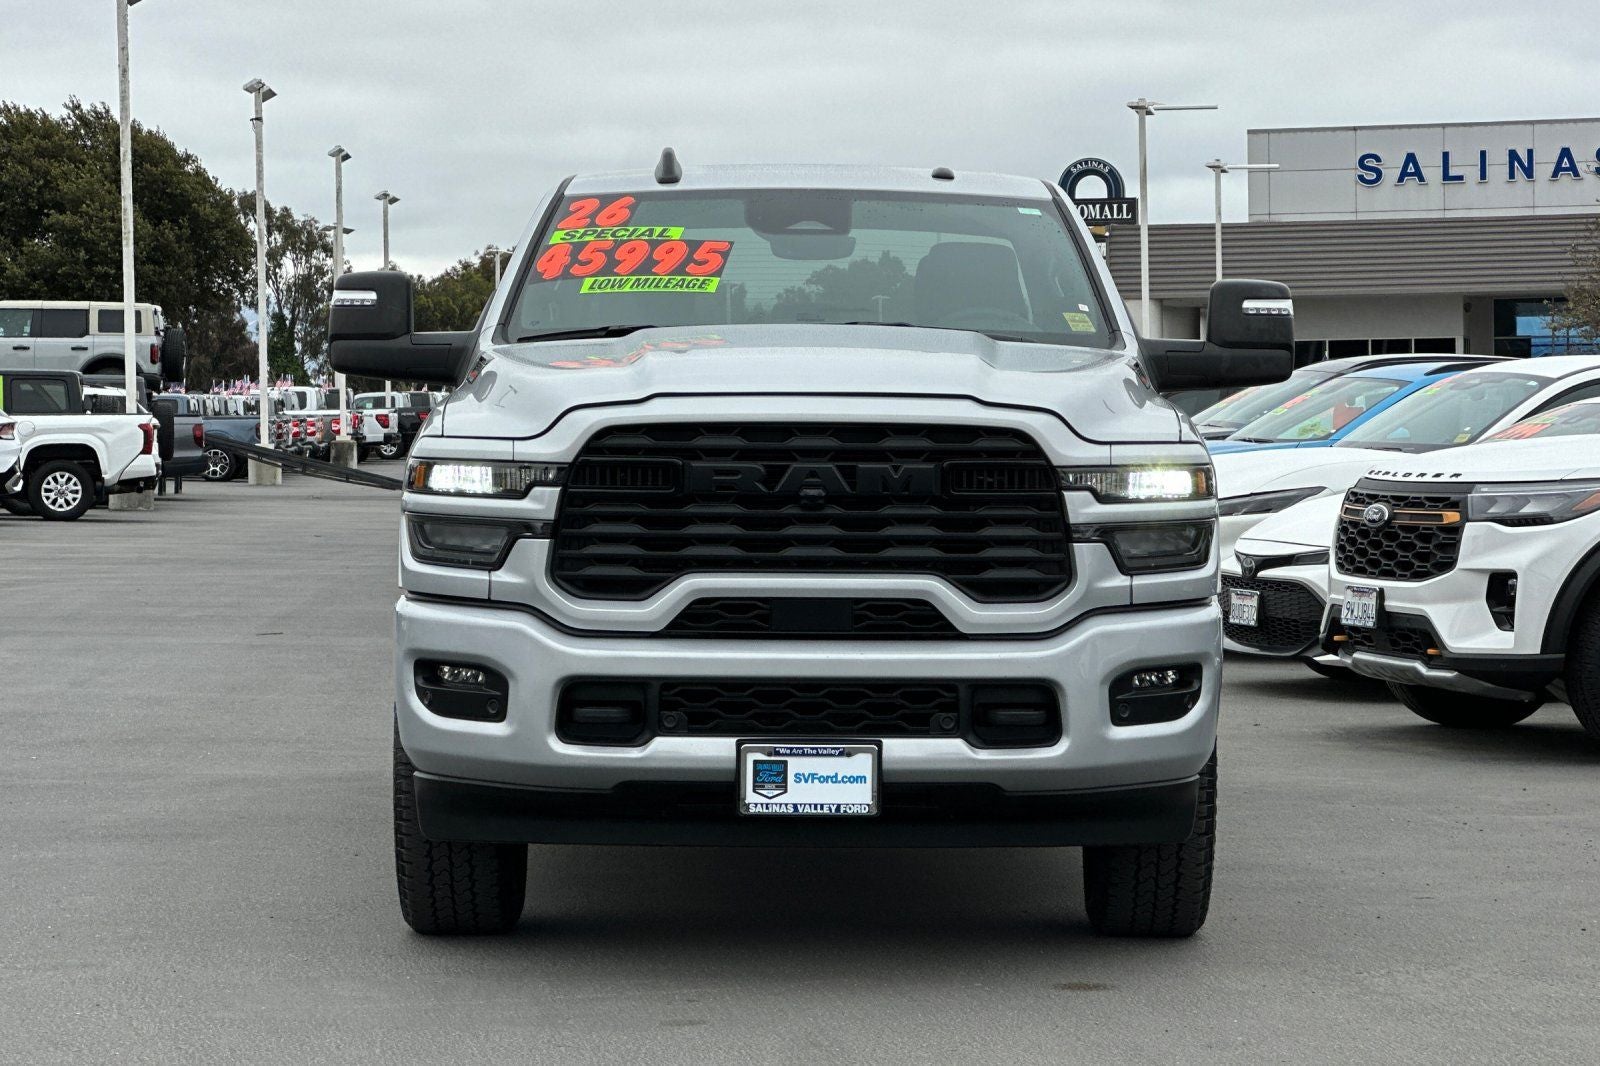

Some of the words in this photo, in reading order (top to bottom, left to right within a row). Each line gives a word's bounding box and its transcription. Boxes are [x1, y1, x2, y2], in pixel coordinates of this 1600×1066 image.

[1070, 160, 1110, 174] SALINAS
[1356, 146, 1600, 187] SALINA
[557, 196, 636, 229] 26
[1074, 203, 1132, 220] OMALL
[559, 226, 672, 241] SPECIAL
[536, 240, 731, 279] 45995
[587, 277, 629, 290] LOW
[629, 277, 713, 290] MILEAGE
[693, 463, 936, 496] RAM
[1367, 469, 1463, 479] EXPLORER
[756, 771, 783, 782] Ford
[794, 772, 867, 784] SVFord.com
[749, 803, 794, 813] SALINAS
[797, 803, 837, 813] VALLEY
[840, 804, 869, 813] FORD
